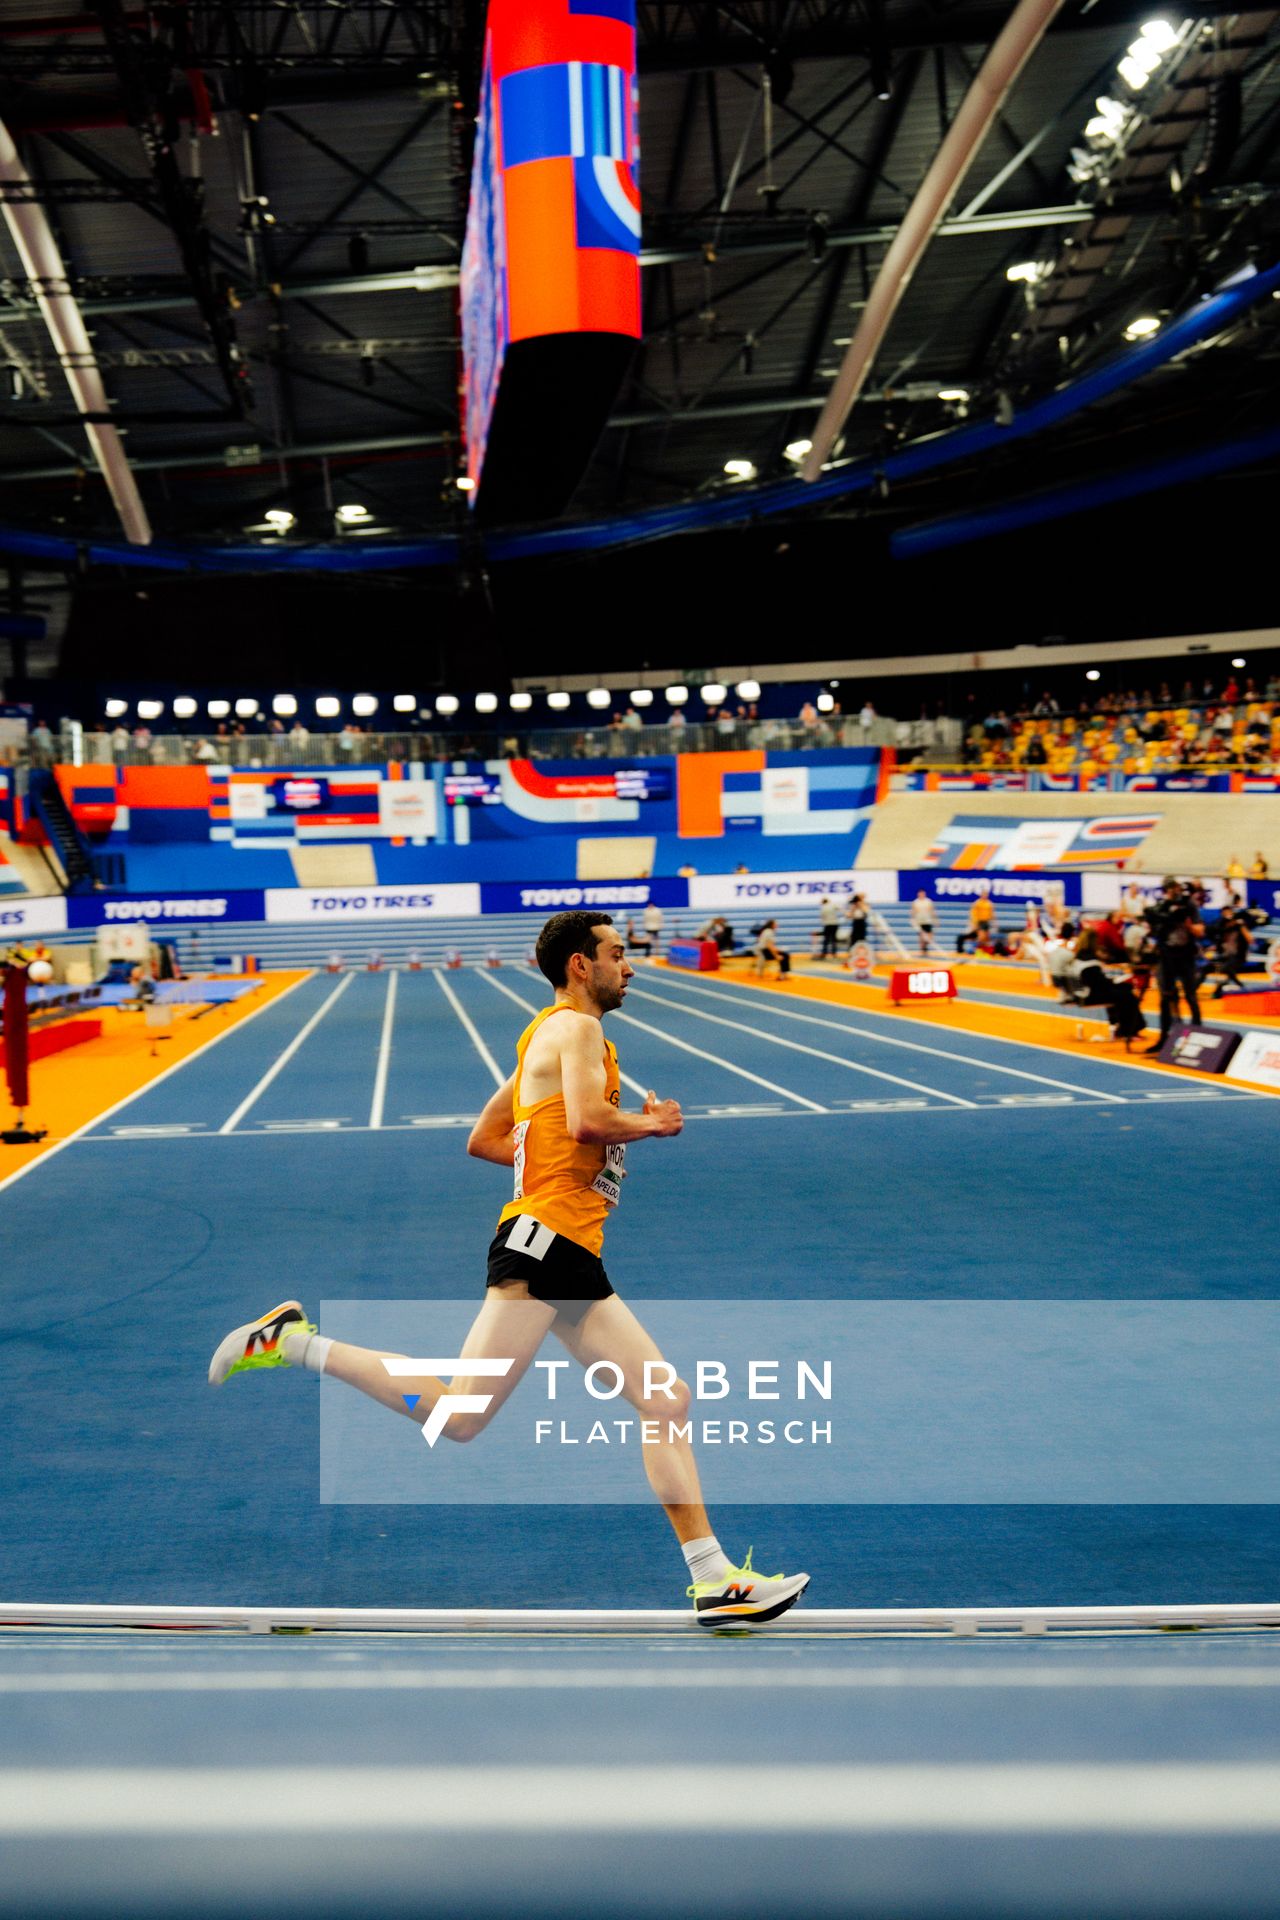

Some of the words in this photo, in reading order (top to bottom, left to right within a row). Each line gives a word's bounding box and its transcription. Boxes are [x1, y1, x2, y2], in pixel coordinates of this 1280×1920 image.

[520, 888, 582, 906] TOYO
[583, 885, 650, 904] TIRES
[736, 883, 791, 896] TOYO
[797, 880, 856, 894] TIRES
[104, 900, 161, 919] TOYO
[162, 898, 227, 917] TIRES
[311, 897, 367, 910] TOYO
[373, 894, 434, 907] TIRES
[523, 1220, 541, 1248] 1
